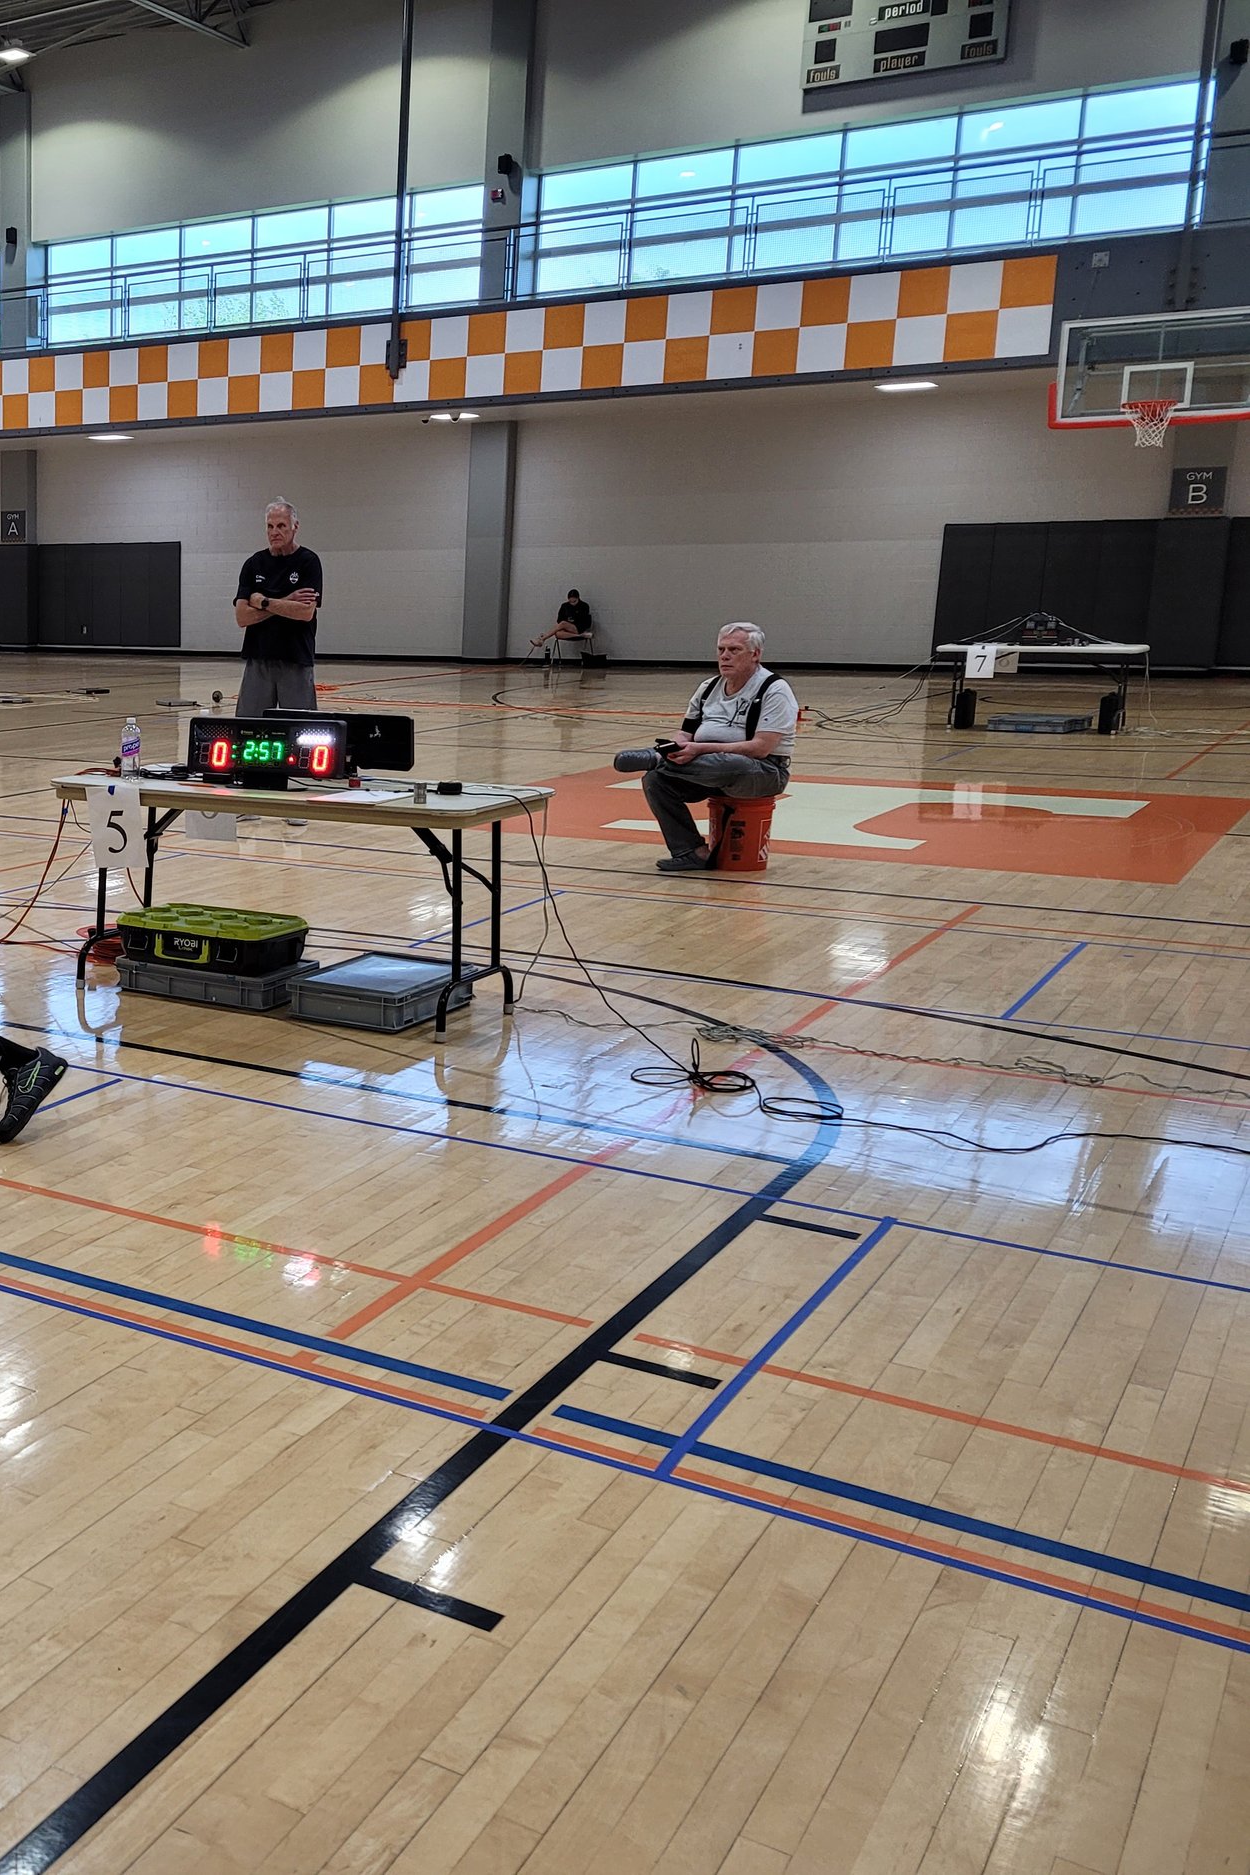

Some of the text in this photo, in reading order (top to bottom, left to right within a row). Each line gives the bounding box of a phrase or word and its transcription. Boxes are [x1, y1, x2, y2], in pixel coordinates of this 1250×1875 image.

[884, 0, 924, 20] period
[964, 42, 993, 58] fouls
[880, 55, 919, 72] player
[810, 67, 837, 82] fouls
[1186, 471, 1213, 480] GYM
[1187, 483, 1208, 504] B
[7, 521, 19, 536] A
[974, 654, 988, 673] 7
[211, 741, 228, 766] 0
[243, 740, 283, 760] 2:57
[312, 745, 329, 771] 0
[106, 810, 128, 853] 5
[173, 937, 199, 948] RYOBI
